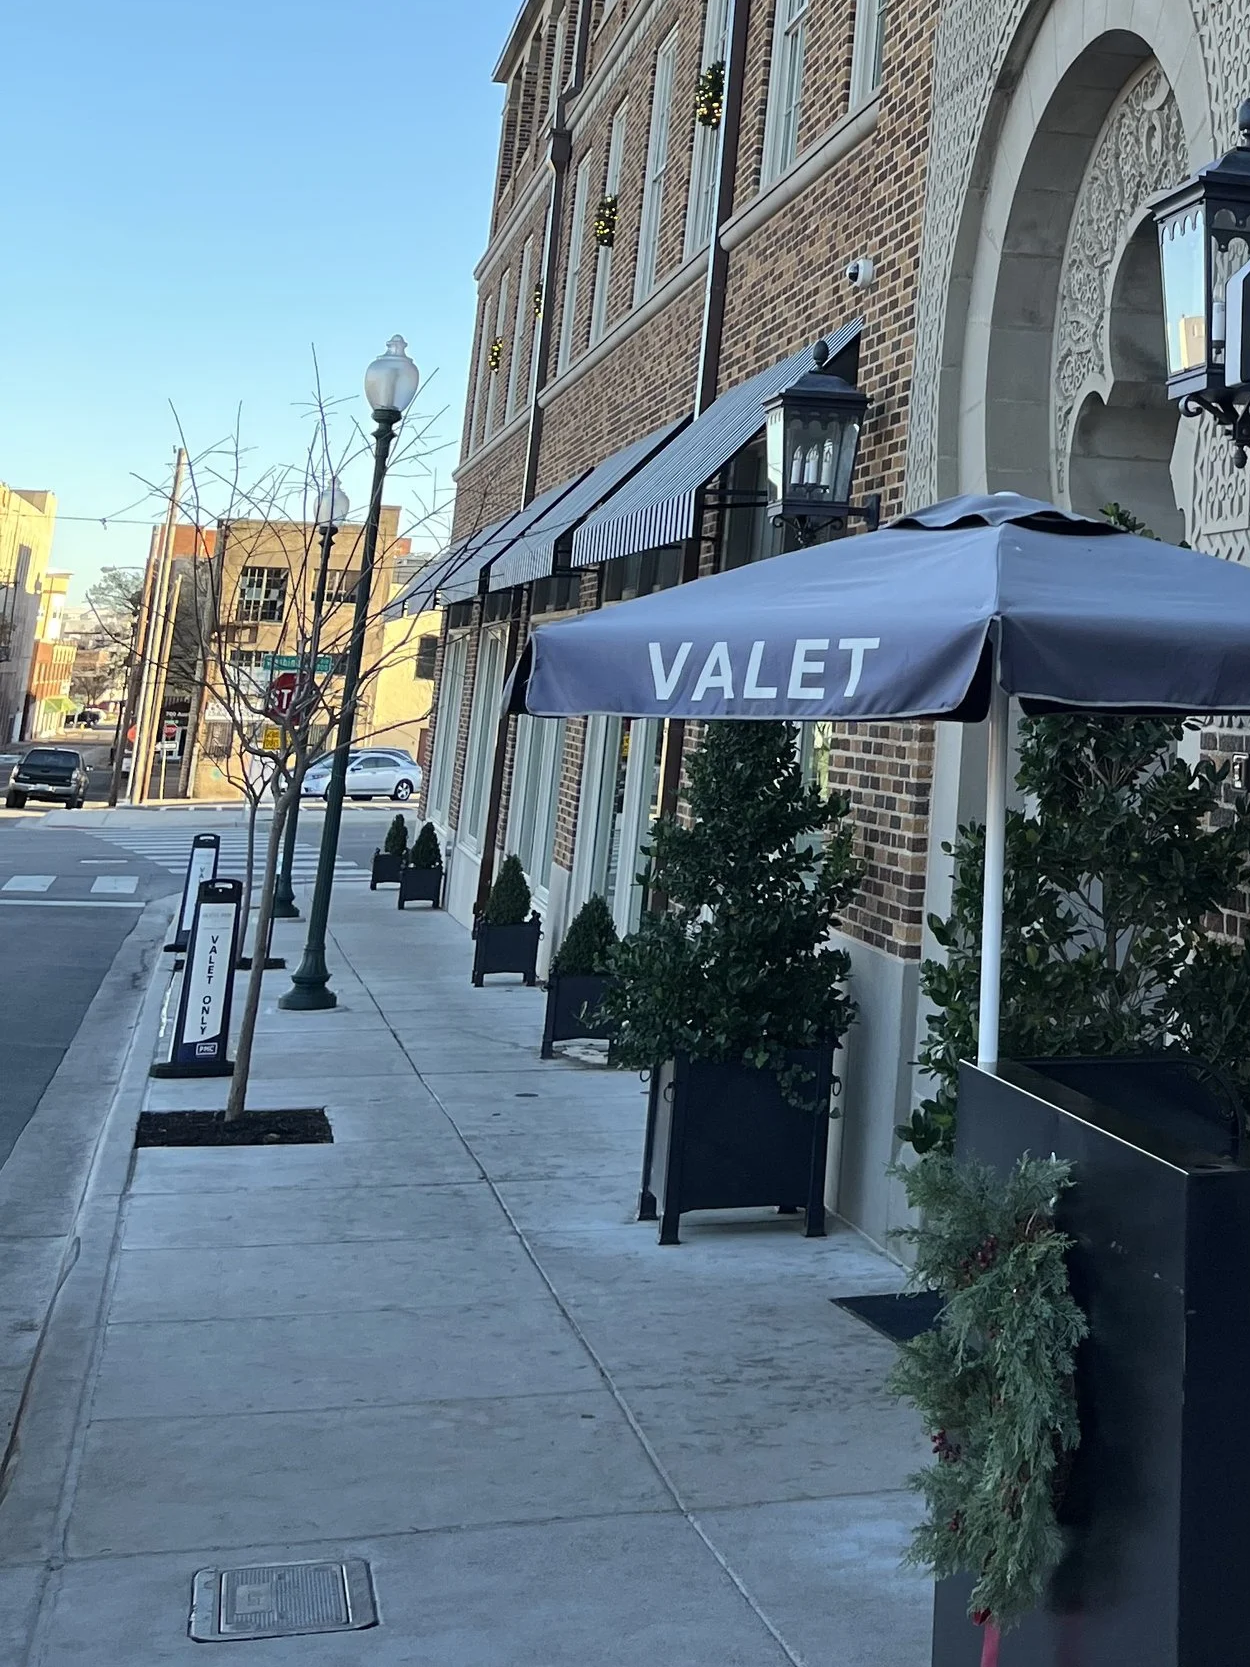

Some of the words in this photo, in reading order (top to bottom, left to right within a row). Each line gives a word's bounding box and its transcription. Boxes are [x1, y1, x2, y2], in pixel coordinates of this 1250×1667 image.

[647, 636, 881, 703] VALET
[206, 935, 219, 985] VALET
[199, 995, 212, 1035] ONLY
